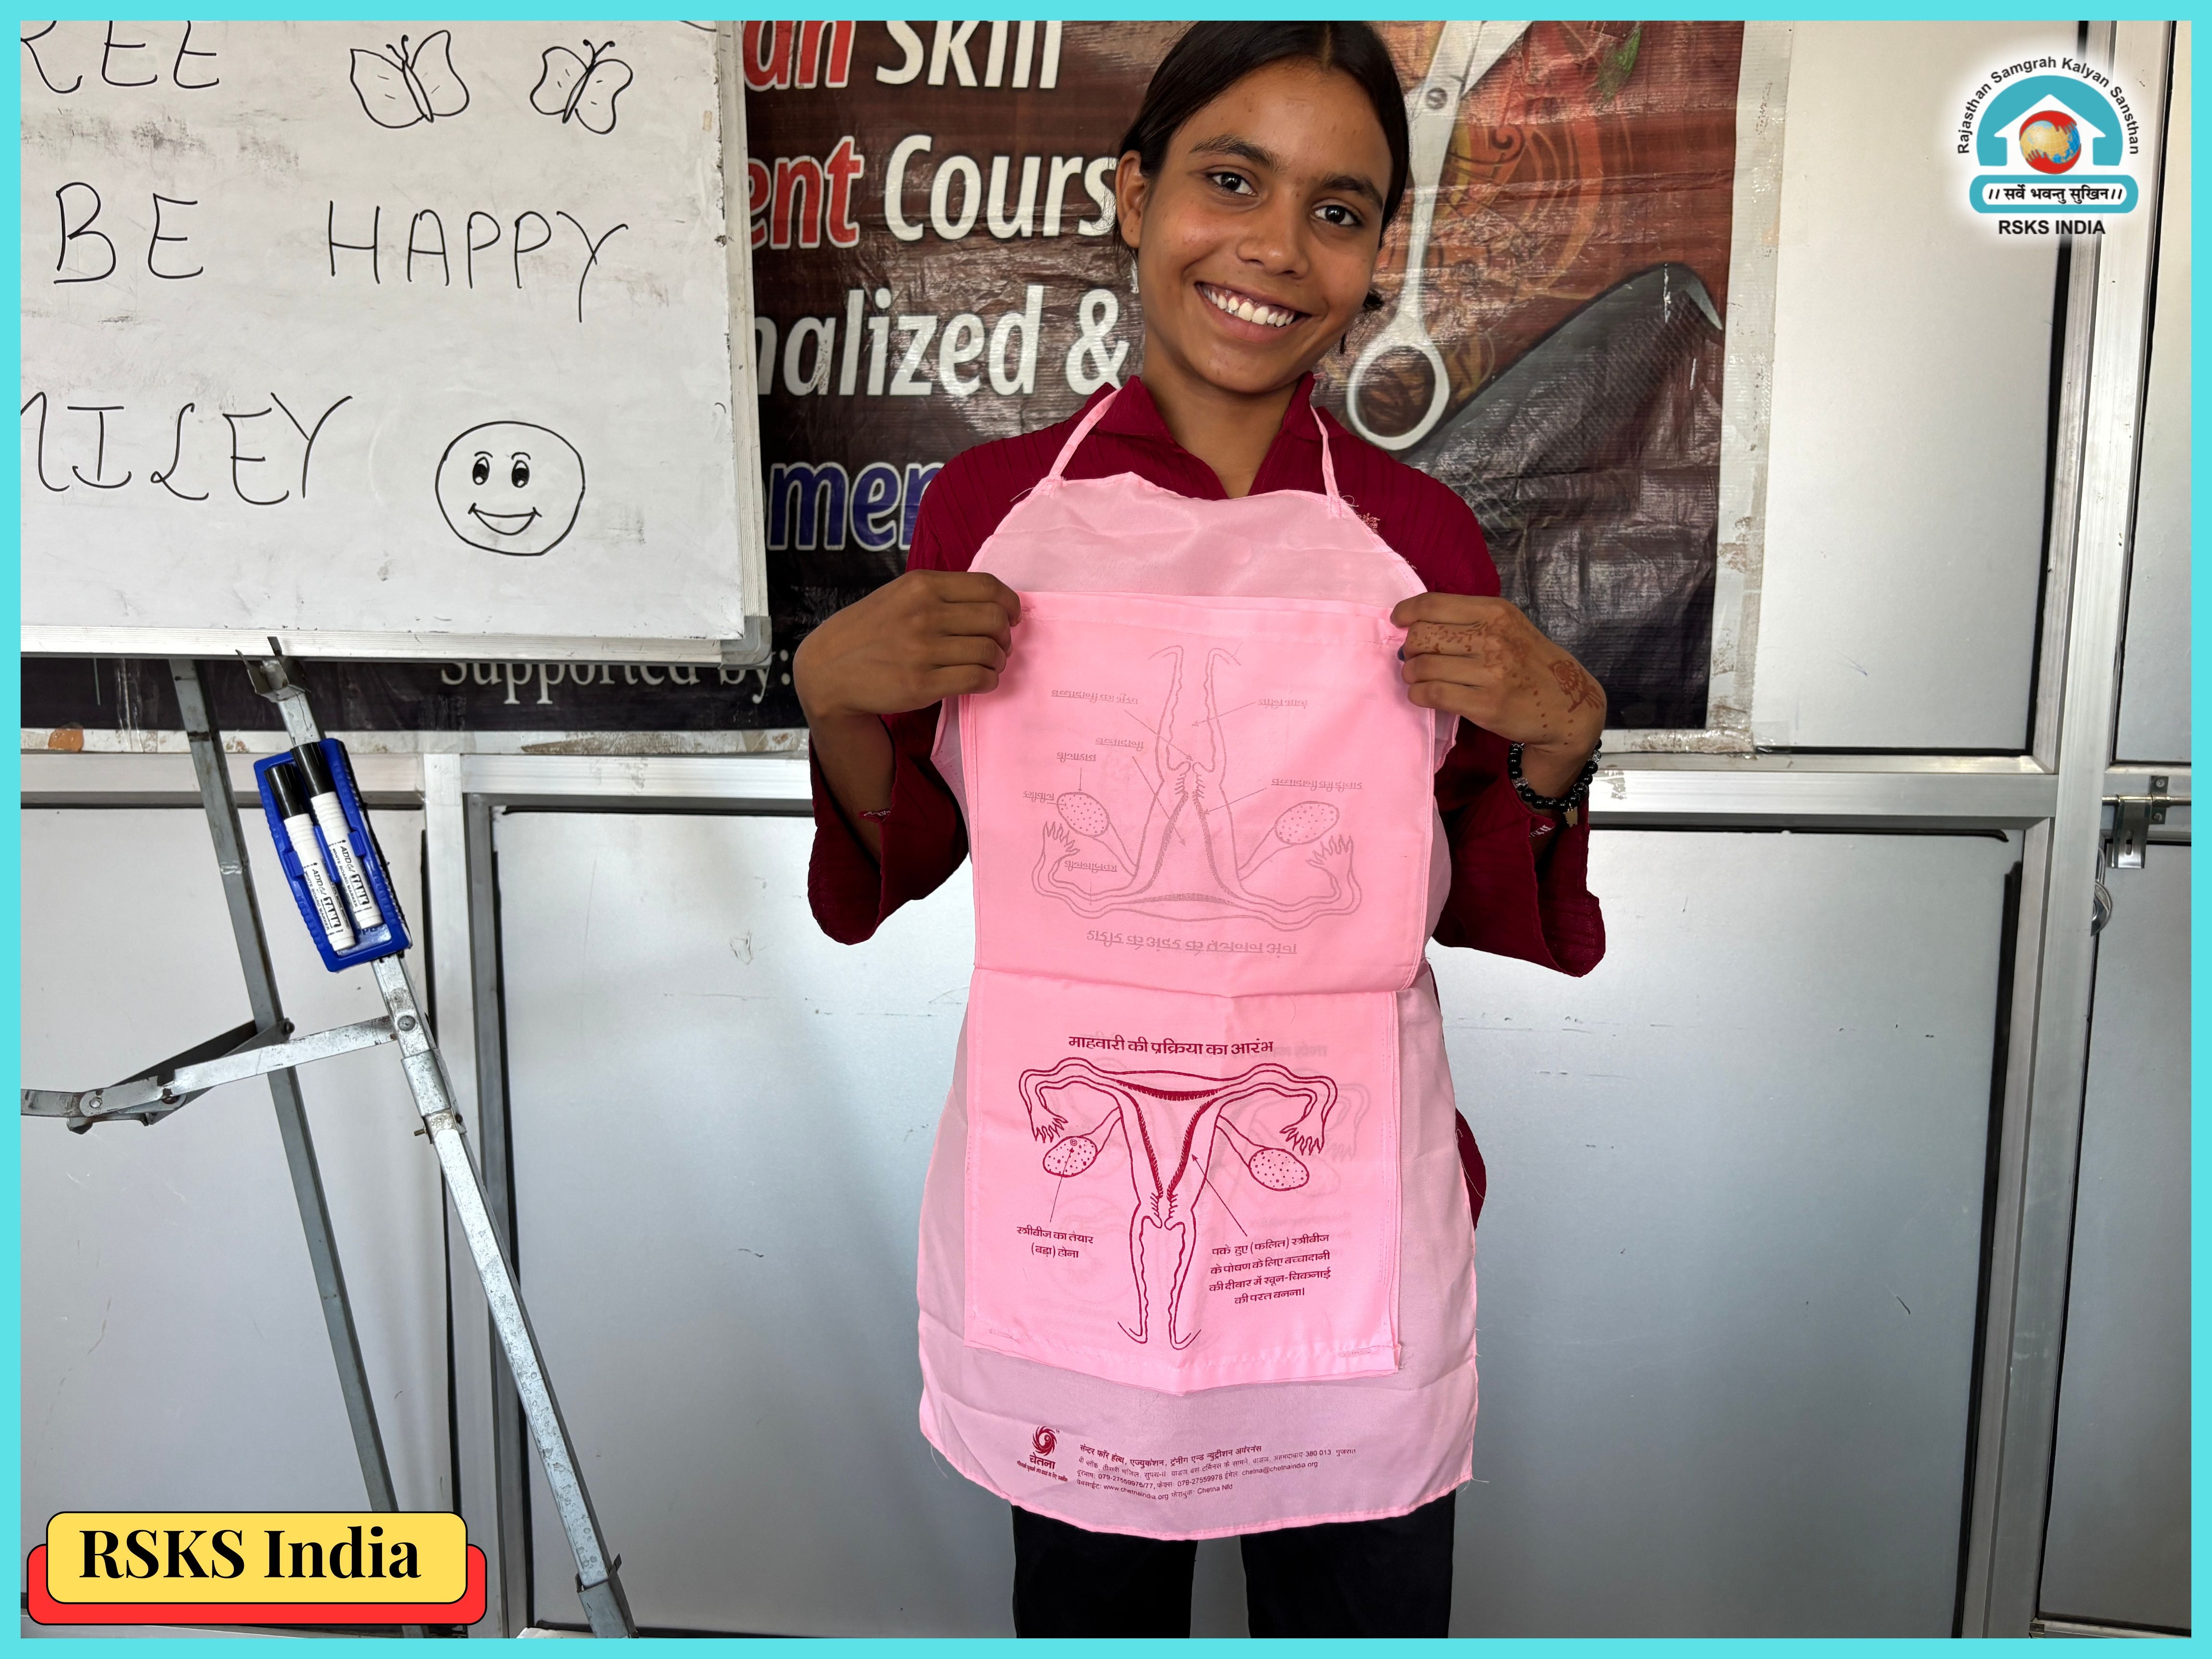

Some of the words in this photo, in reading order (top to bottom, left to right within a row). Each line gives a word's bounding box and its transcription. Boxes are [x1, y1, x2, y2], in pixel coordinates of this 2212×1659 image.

[54, 182, 204, 283] BE
[330, 200, 628, 323] HAPPY
[1065, 289, 1130, 395] &
[332, 848, 341, 866] WHITE
[339, 866, 349, 884] BOARD
[347, 884, 358, 907] MARKER
[340, 846, 351, 865] ADD
[349, 874, 370, 905] TANK
[312, 868, 324, 887] ADD
[323, 896, 341, 928] TANK
[312, 888, 321, 909] BOARD
[319, 908, 330, 931] MARKER
[1068, 1034, 1125, 1050] माहवारी
[1127, 1036, 1149, 1052] की
[1151, 1037, 1203, 1054] प्रक्रिया
[1206, 1044, 1228, 1055] का
[1231, 1038, 1274, 1055] आरंभ
[1016, 1224, 1052, 1238] स्त्रीबीज
[1053, 1231, 1067, 1240] का
[1058, 1246, 1079, 1258] होना
[1212, 1244, 1231, 1256] पके
[1234, 1244, 1248, 1256] हुए
[1250, 1236, 1289, 1254] (फलित)
[1291, 1232, 1330, 1245] स्त्रीबीज
[1210, 1263, 1222, 1274] के
[1223, 1262, 1250, 1273] पोषण
[1252, 1258, 1263, 1269] के
[1264, 1257, 1284, 1267] लिए
[1284, 1250, 1330, 1264] बच्चादानी
[1209, 1280, 1224, 1292] की
[1225, 1279, 1252, 1291] दीवार
[1253, 1275, 1262, 1286] में
[1234, 1293, 1248, 1304] की
[1250, 1292, 1272, 1302] परत
[1029, 1452, 1056, 1470] चेतना
[1242, 1462, 1318, 1476] chetna@chetnaindiaorg
[1103, 1484, 1169, 1501] wwwchetnaindia.org
